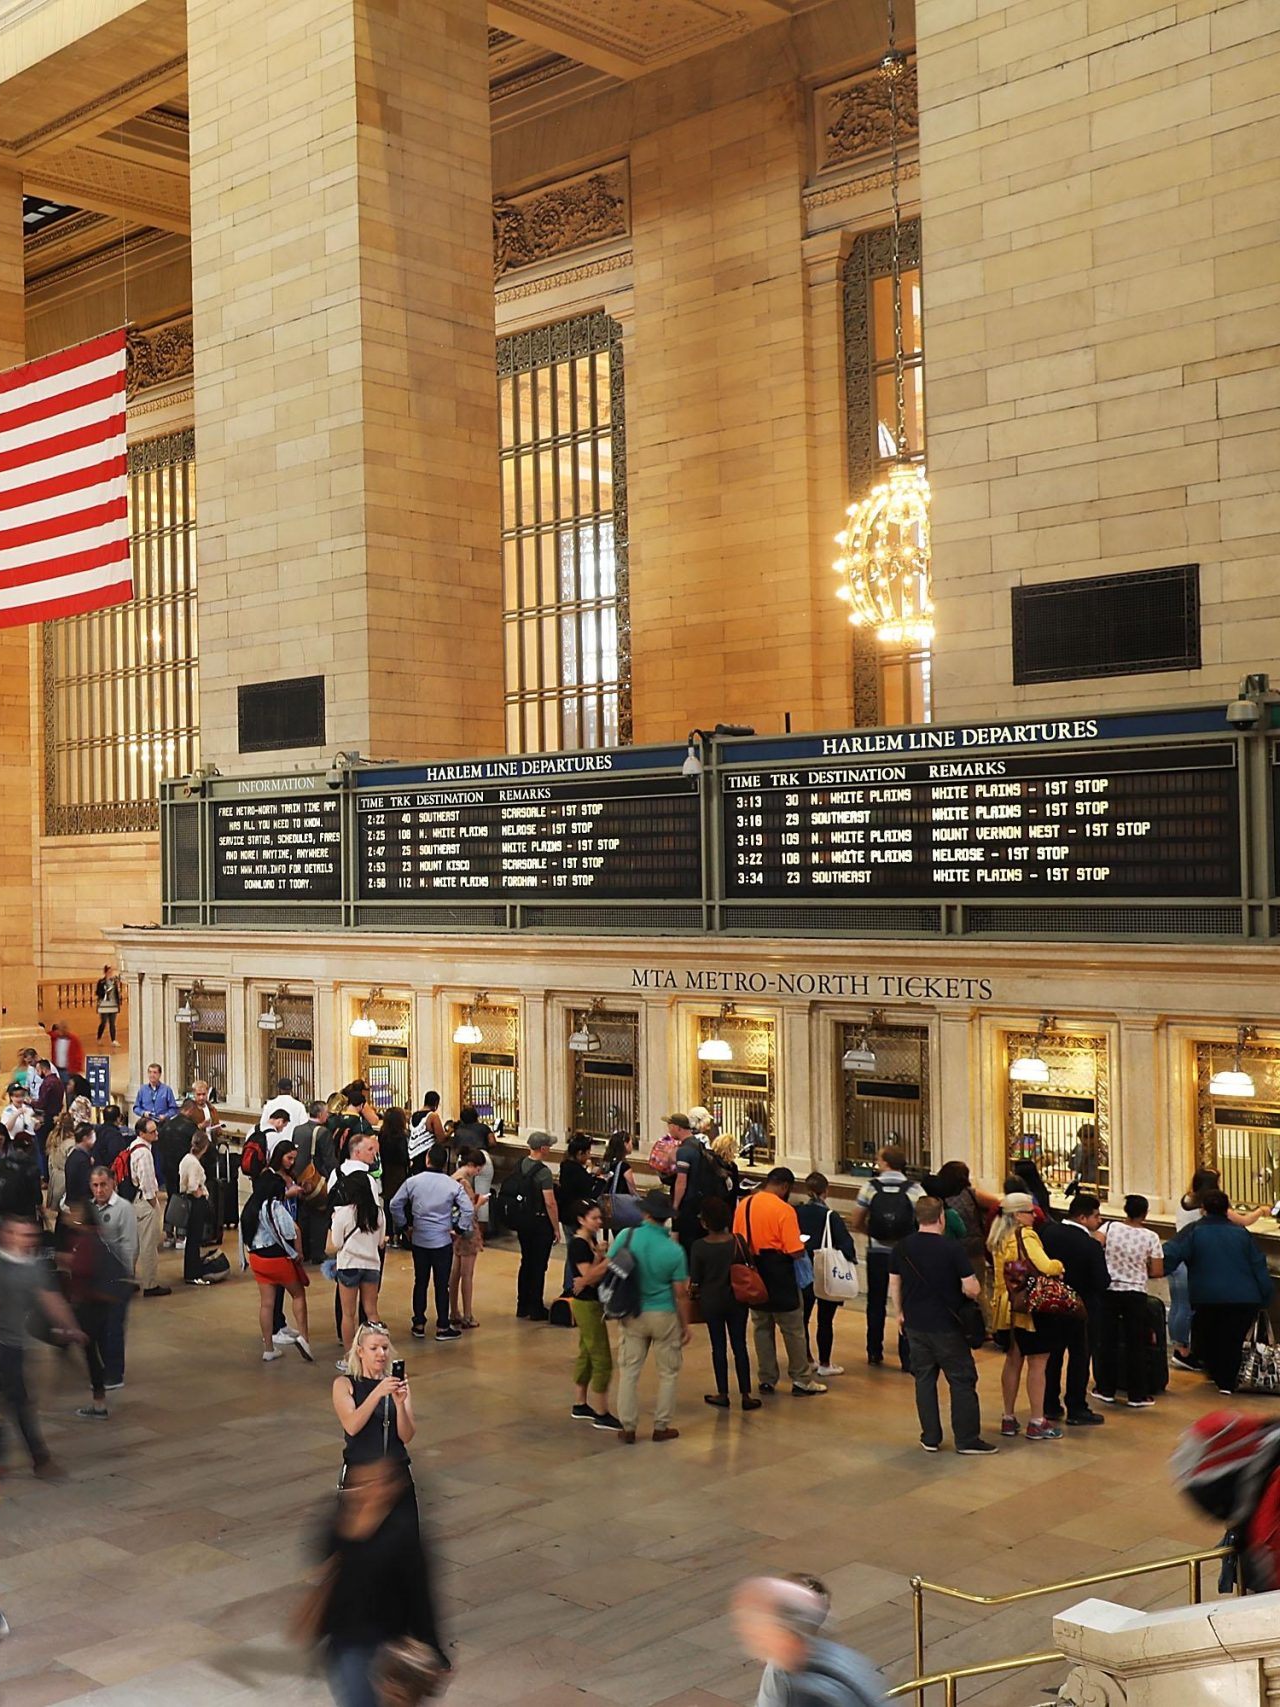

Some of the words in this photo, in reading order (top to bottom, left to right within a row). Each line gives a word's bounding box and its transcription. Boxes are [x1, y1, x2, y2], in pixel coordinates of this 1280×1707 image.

[822, 734, 904, 755] HARLEM
[908, 731, 955, 750] LINE
[961, 720, 1098, 746] DEPARTURES
[426, 764, 482, 781] HARLEM
[486, 762, 518, 777] LINE
[522, 754, 612, 774] DEPARTURES
[728, 775, 760, 788] TIME
[770, 773, 800, 786] TRK
[808, 767, 906, 784] DESTINATION
[928, 762, 1006, 778] REMARKS
[238, 777, 315, 792] INFORMATION
[360, 798, 384, 808] TIME
[390, 796, 411, 806] TRK
[416, 792, 484, 806] DESTINATION
[500, 788, 551, 801] REMARKS
[736, 796, 762, 808] 3:13
[786, 794, 798, 806] 30
[811, 793, 822, 806] N.
[830, 791, 864, 804] WHITE
[870, 789, 912, 803] PLAINS
[932, 786, 968, 800] WHITE
[975, 783, 1021, 798] PLAINS
[1045, 781, 1068, 796] 1ST
[1075, 779, 1108, 794] STOP
[219, 806, 233, 816] FREE
[236, 804, 277, 816] METRO-NORTH
[281, 803, 300, 814] TRAIN
[304, 802, 320, 812] TIME
[324, 801, 336, 811] APP
[368, 814, 385, 825] 2:22
[402, 813, 411, 823] 40
[419, 811, 459, 822] SOUTHEAST
[502, 807, 546, 819] SCARSDALE
[562, 805, 577, 816] 1ST
[582, 804, 603, 816] STOP
[786, 813, 800, 826] 29
[811, 810, 870, 825] SOUTHEAST
[932, 807, 969, 820] WHITE
[976, 804, 1021, 820] PLAINS
[1045, 802, 1068, 816] 1ST
[1075, 801, 1109, 815] STOP
[229, 821, 240, 831] HAS
[244, 820, 255, 830] ALL
[259, 820, 270, 829] YOU
[274, 819, 289, 829] NEED
[293, 818, 300, 828] TO
[368, 830, 385, 840] 2:25
[398, 829, 411, 839] 108
[419, 829, 427, 839] N.
[433, 827, 455, 838] WHITE
[460, 826, 488, 837] PLAINS
[502, 824, 536, 836] MELROSE
[552, 823, 566, 834] 1ST
[572, 822, 593, 834] STOP
[219, 836, 244, 846] SERVICE
[248, 835, 273, 845] STATUS,
[278, 833, 316, 844] SCHEDULES,
[320, 832, 340, 842] FARES
[737, 834, 762, 846] 3:19
[781, 833, 800, 845] 109
[812, 832, 823, 845] N.
[831, 831, 864, 843] WHITE
[870, 829, 912, 843] PLAINS
[932, 828, 969, 841] MOUNT
[976, 826, 1022, 840] VERNON
[1029, 825, 1060, 838] WEST
[1085, 823, 1108, 837] 1ST
[1116, 822, 1151, 836] STOP
[226, 850, 237, 860] AND
[297, 848, 329, 858] ANYWHERE
[368, 846, 385, 856] 2:47
[402, 845, 411, 855] 25
[419, 844, 460, 855] SOUTHEAST
[502, 842, 527, 853] WHITE
[531, 841, 562, 852] PLAINS
[578, 840, 593, 851] 1ST
[598, 839, 619, 850] STOP
[737, 853, 762, 865] 3:22
[782, 852, 800, 865] 108
[812, 852, 824, 864] N.
[831, 850, 865, 863] WHITE
[870, 849, 912, 863] PLAINS
[932, 848, 984, 862] MELROSE
[1008, 847, 1029, 860] 1ST
[1037, 846, 1069, 860] STOP
[289, 864, 301, 874] FOR
[304, 863, 333, 873] DETAILS
[368, 862, 386, 872] 2:53
[402, 861, 411, 871] 23
[419, 860, 442, 871] MOUNT
[446, 860, 470, 871] KISCO
[502, 858, 547, 870] SCARSDALE
[563, 858, 578, 869] 1ST
[582, 857, 604, 868] STOP
[245, 880, 274, 889] DOWNLOAD
[278, 879, 286, 889] IT
[399, 877, 411, 888] 112
[420, 877, 428, 887] N.
[433, 876, 456, 887] WHITE
[460, 876, 488, 887] PLAINS
[502, 876, 538, 887] FORDHAM
[552, 875, 567, 886] 1ST
[572, 875, 594, 886] STOP
[738, 872, 763, 884] 3:34
[787, 872, 800, 884] 23
[812, 871, 871, 884] SOUTHEAST
[933, 869, 970, 882] WHITE
[977, 868, 1022, 881] PLAINS
[1046, 867, 1069, 881] 1ST
[1076, 867, 1110, 880] STOP
[632, 969, 677, 988] MTA
[686, 970, 869, 996] METRO-NORTH
[878, 976, 992, 1000] TICKETS
[832, 1266, 853, 1280] fuel
